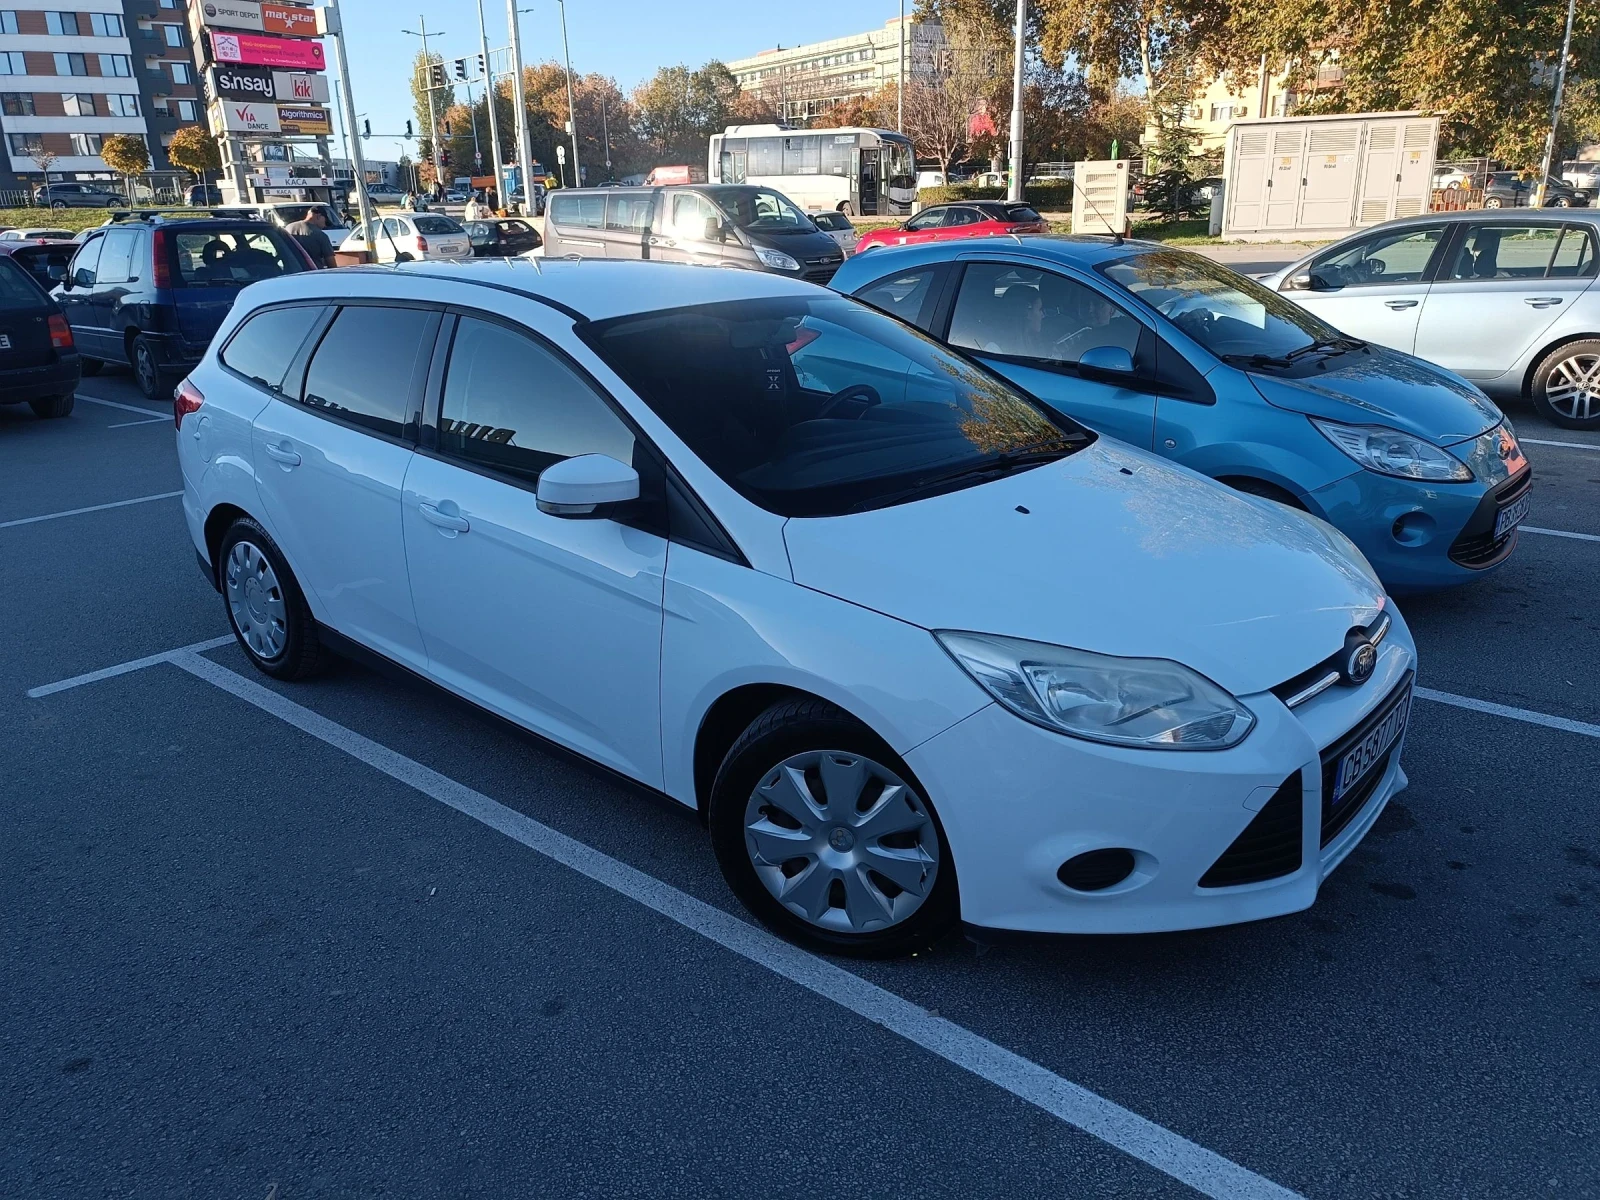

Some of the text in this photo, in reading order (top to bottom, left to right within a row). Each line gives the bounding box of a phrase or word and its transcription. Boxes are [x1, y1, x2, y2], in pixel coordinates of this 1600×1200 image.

[218, 8, 259, 19] SPORT DEPOT
[219, 72, 274, 98] sinsay
[294, 79, 311, 97] kik
[281, 109, 324, 120] Algorithmics
[1343, 745, 1362, 788] CB
[1363, 712, 1393, 769] 5877
